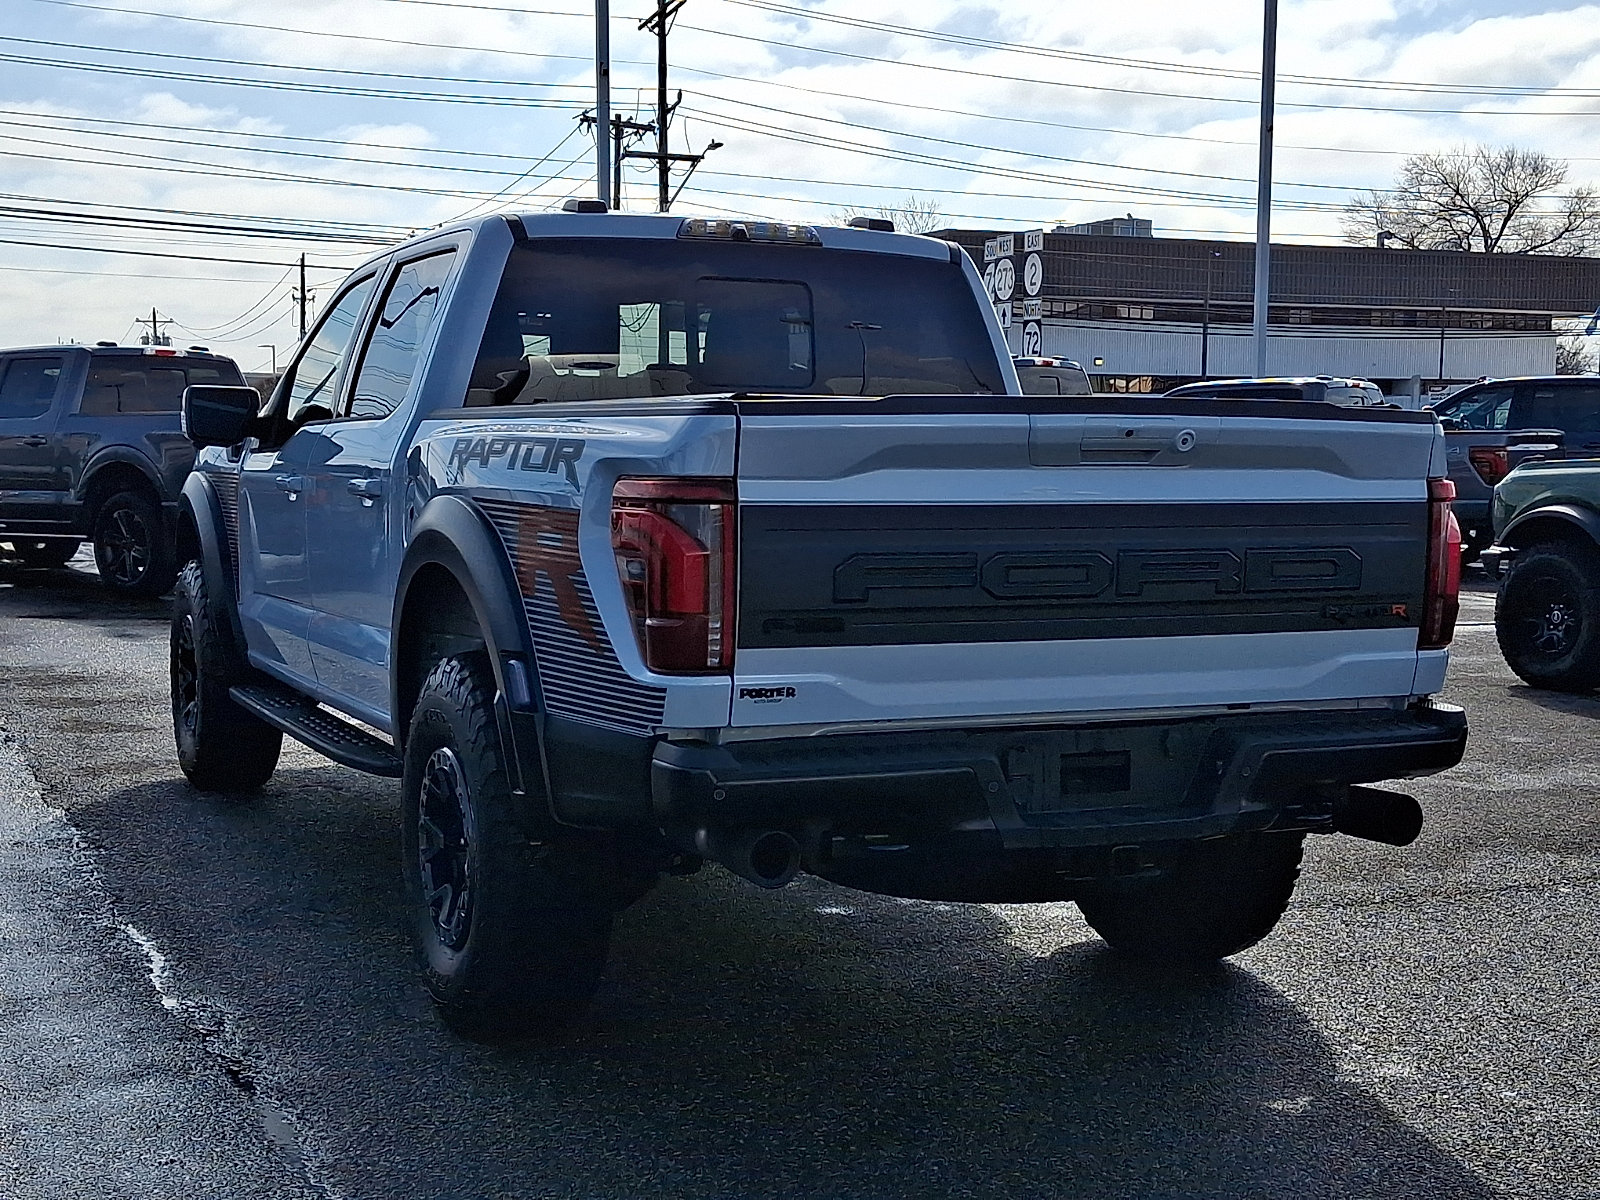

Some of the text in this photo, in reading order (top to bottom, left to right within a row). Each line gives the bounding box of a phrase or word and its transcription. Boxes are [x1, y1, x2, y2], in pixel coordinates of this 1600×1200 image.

[998, 239, 1012, 254] WEST
[1027, 234, 1040, 248] EAST
[997, 266, 1014, 291] 273
[1029, 262, 1037, 286] 2
[1025, 330, 1039, 355] 72
[449, 436, 585, 493] RAPTOR
[833, 546, 1363, 602] FORD
[740, 686, 796, 699] PORTER
